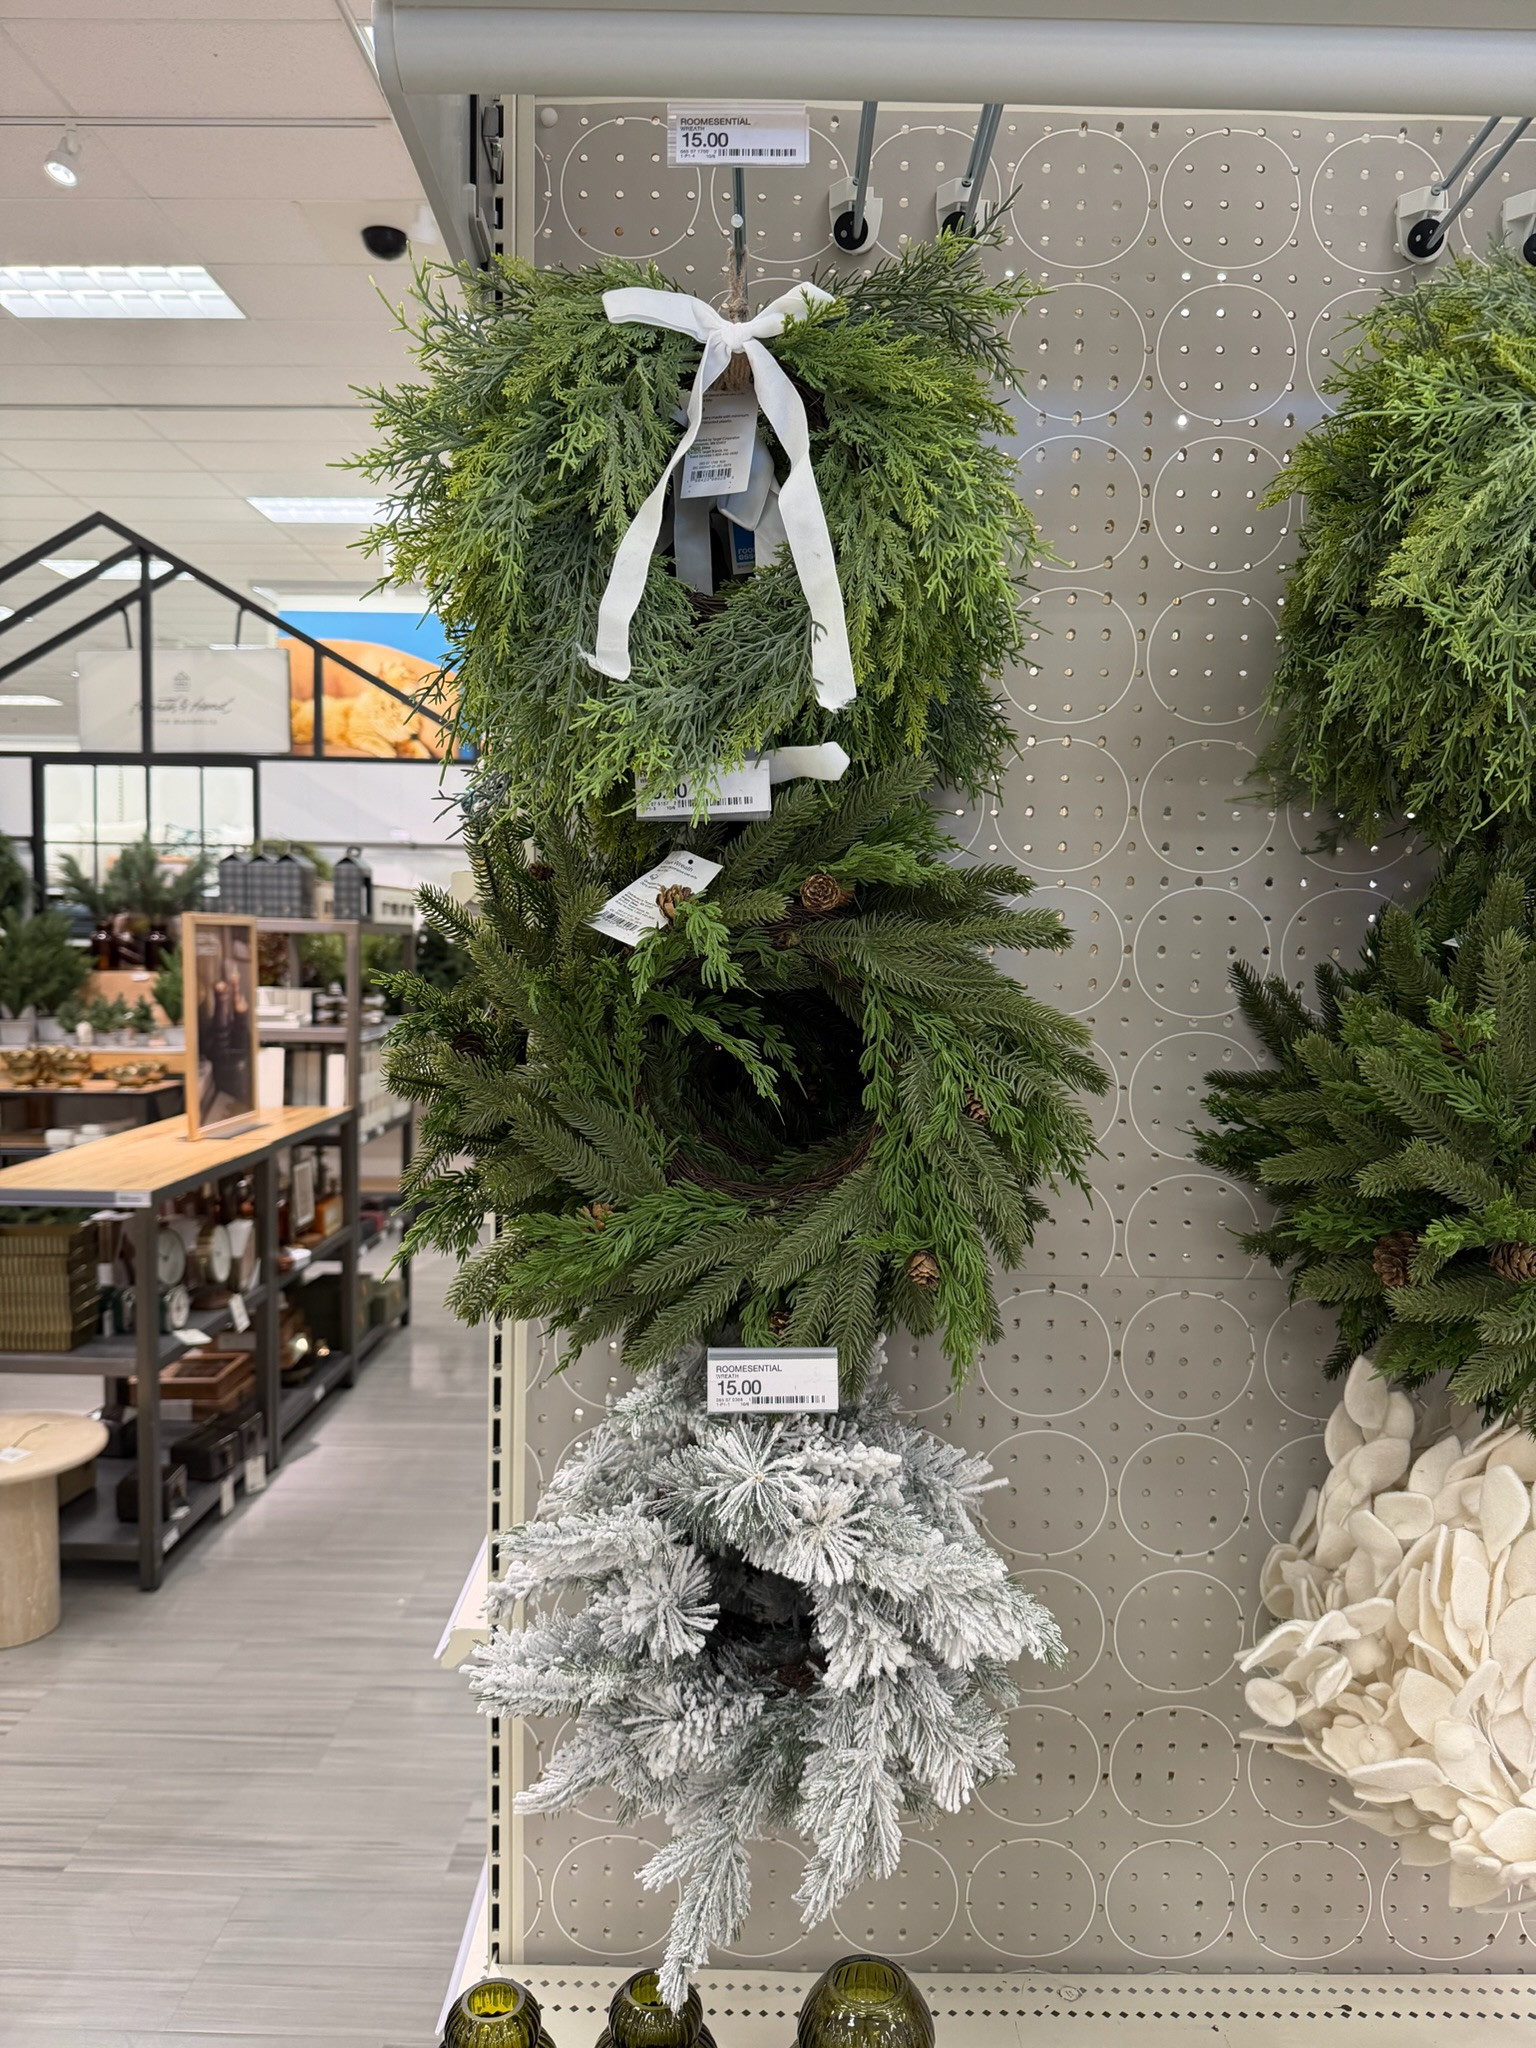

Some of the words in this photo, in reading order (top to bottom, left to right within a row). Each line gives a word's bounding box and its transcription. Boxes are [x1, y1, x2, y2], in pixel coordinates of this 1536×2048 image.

[680, 118, 751, 126] ROOMESENTIAL
[682, 132, 729, 147] 15.00
[716, 1365, 782, 1373] ROOMESENTIAL
[717, 1379, 762, 1396] 15.00
